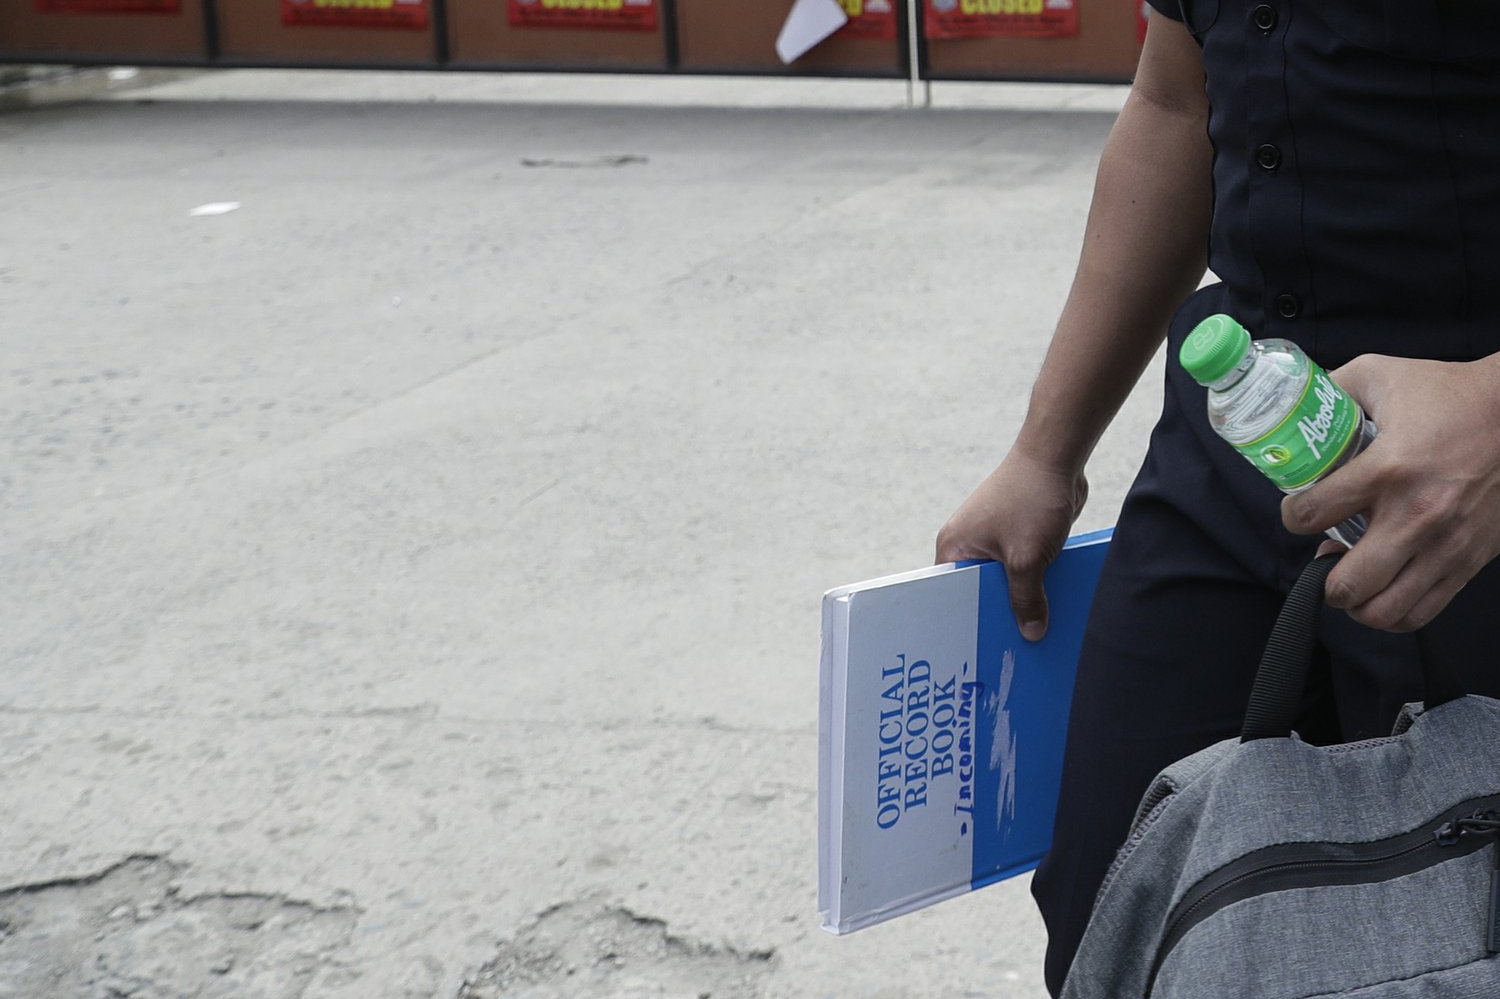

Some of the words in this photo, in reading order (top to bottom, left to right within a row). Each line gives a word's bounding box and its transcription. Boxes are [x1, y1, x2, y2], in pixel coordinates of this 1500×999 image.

[876, 653, 906, 830] OFFICIAL
[904, 659, 931, 813] RECORD
[931, 674, 956, 781] BOOK
